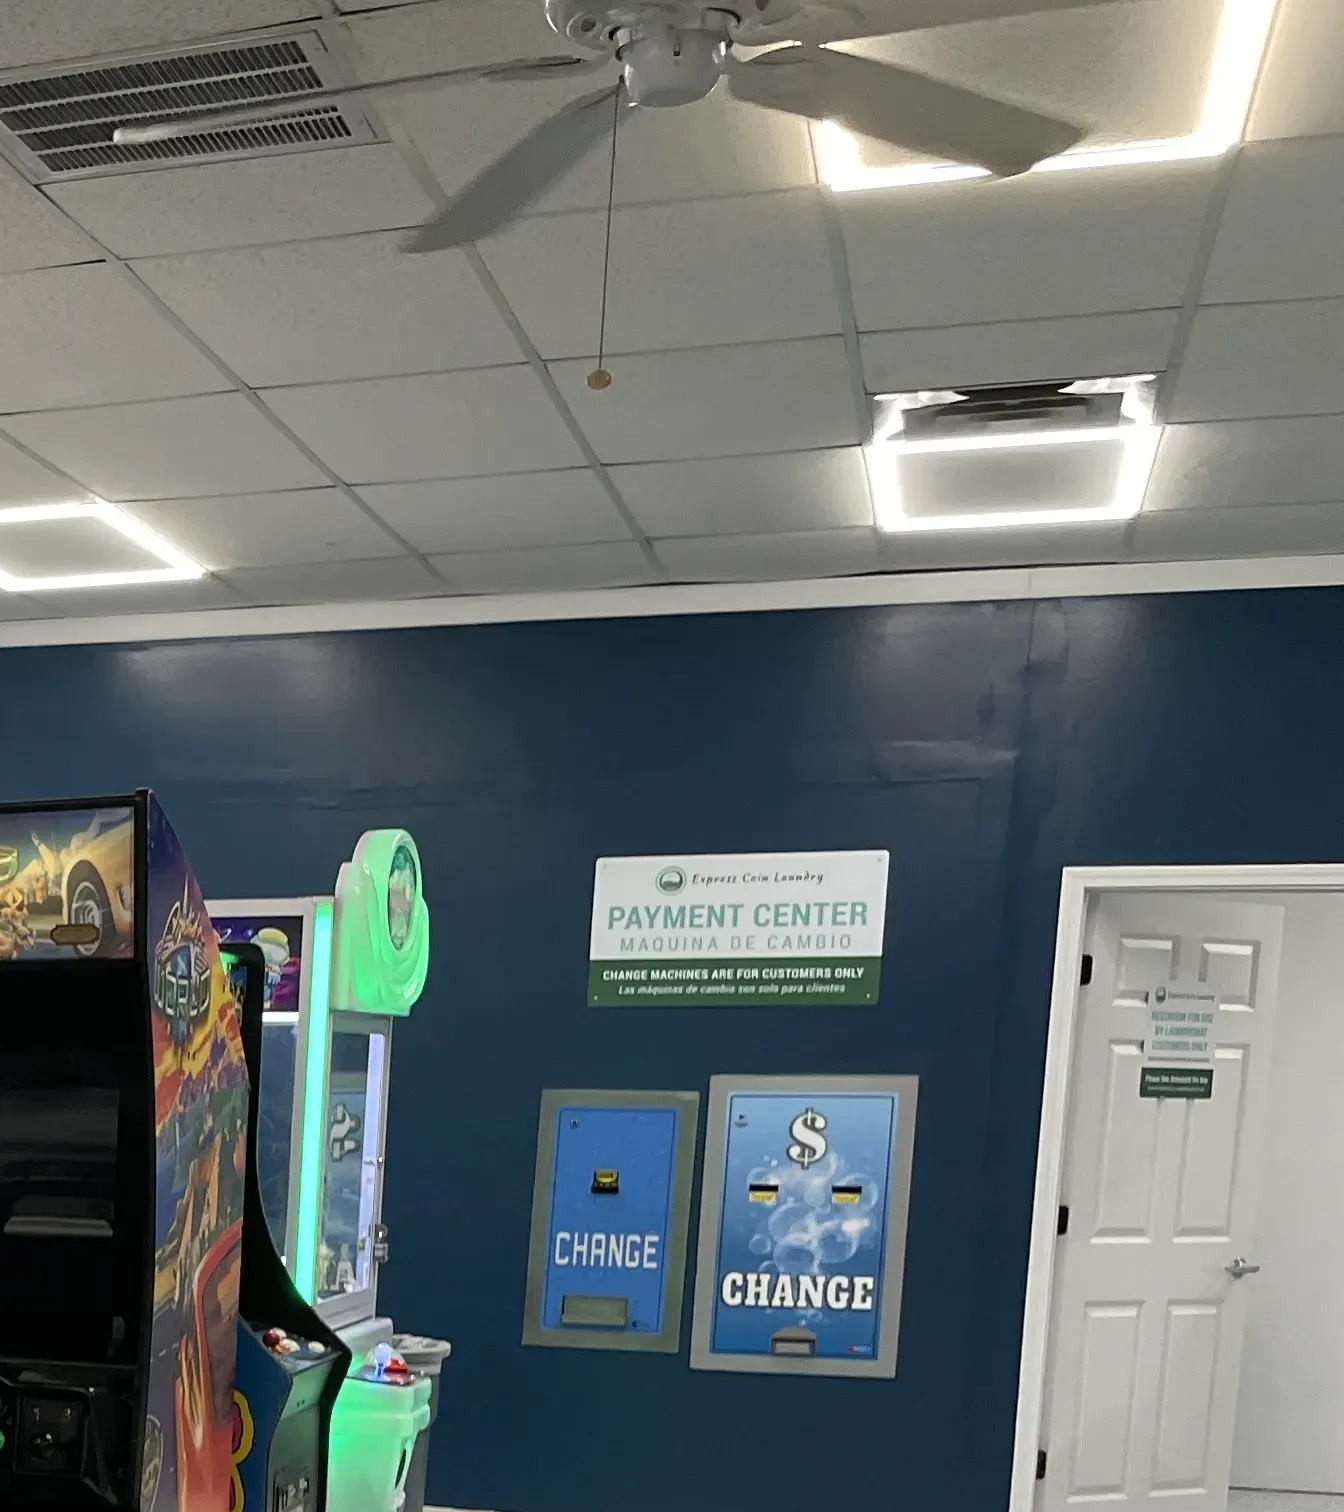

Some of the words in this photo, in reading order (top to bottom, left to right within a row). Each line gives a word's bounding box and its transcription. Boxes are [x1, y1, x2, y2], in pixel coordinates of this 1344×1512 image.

[692, 873, 737, 888] Express
[742, 872, 769, 884] Coin
[773, 870, 824, 886] Laundry
[607, 903, 745, 930] PAYMENT
[753, 901, 868, 928] CENTER
[620, 935, 719, 953] MAQUINA
[730, 935, 757, 950] DE
[767, 933, 852, 950] CAMBIO
[602, 969, 648, 981] CHANGE
[650, 968, 709, 980] MACHINES
[711, 968, 734, 980] ARE
[736, 967, 759, 980] FOR
[761, 967, 832, 980] CUSTOMERS
[834, 967, 865, 979] ONLY
[553, 1231, 660, 1270] CHANGE
[721, 1271, 875, 1311] CHANGE
